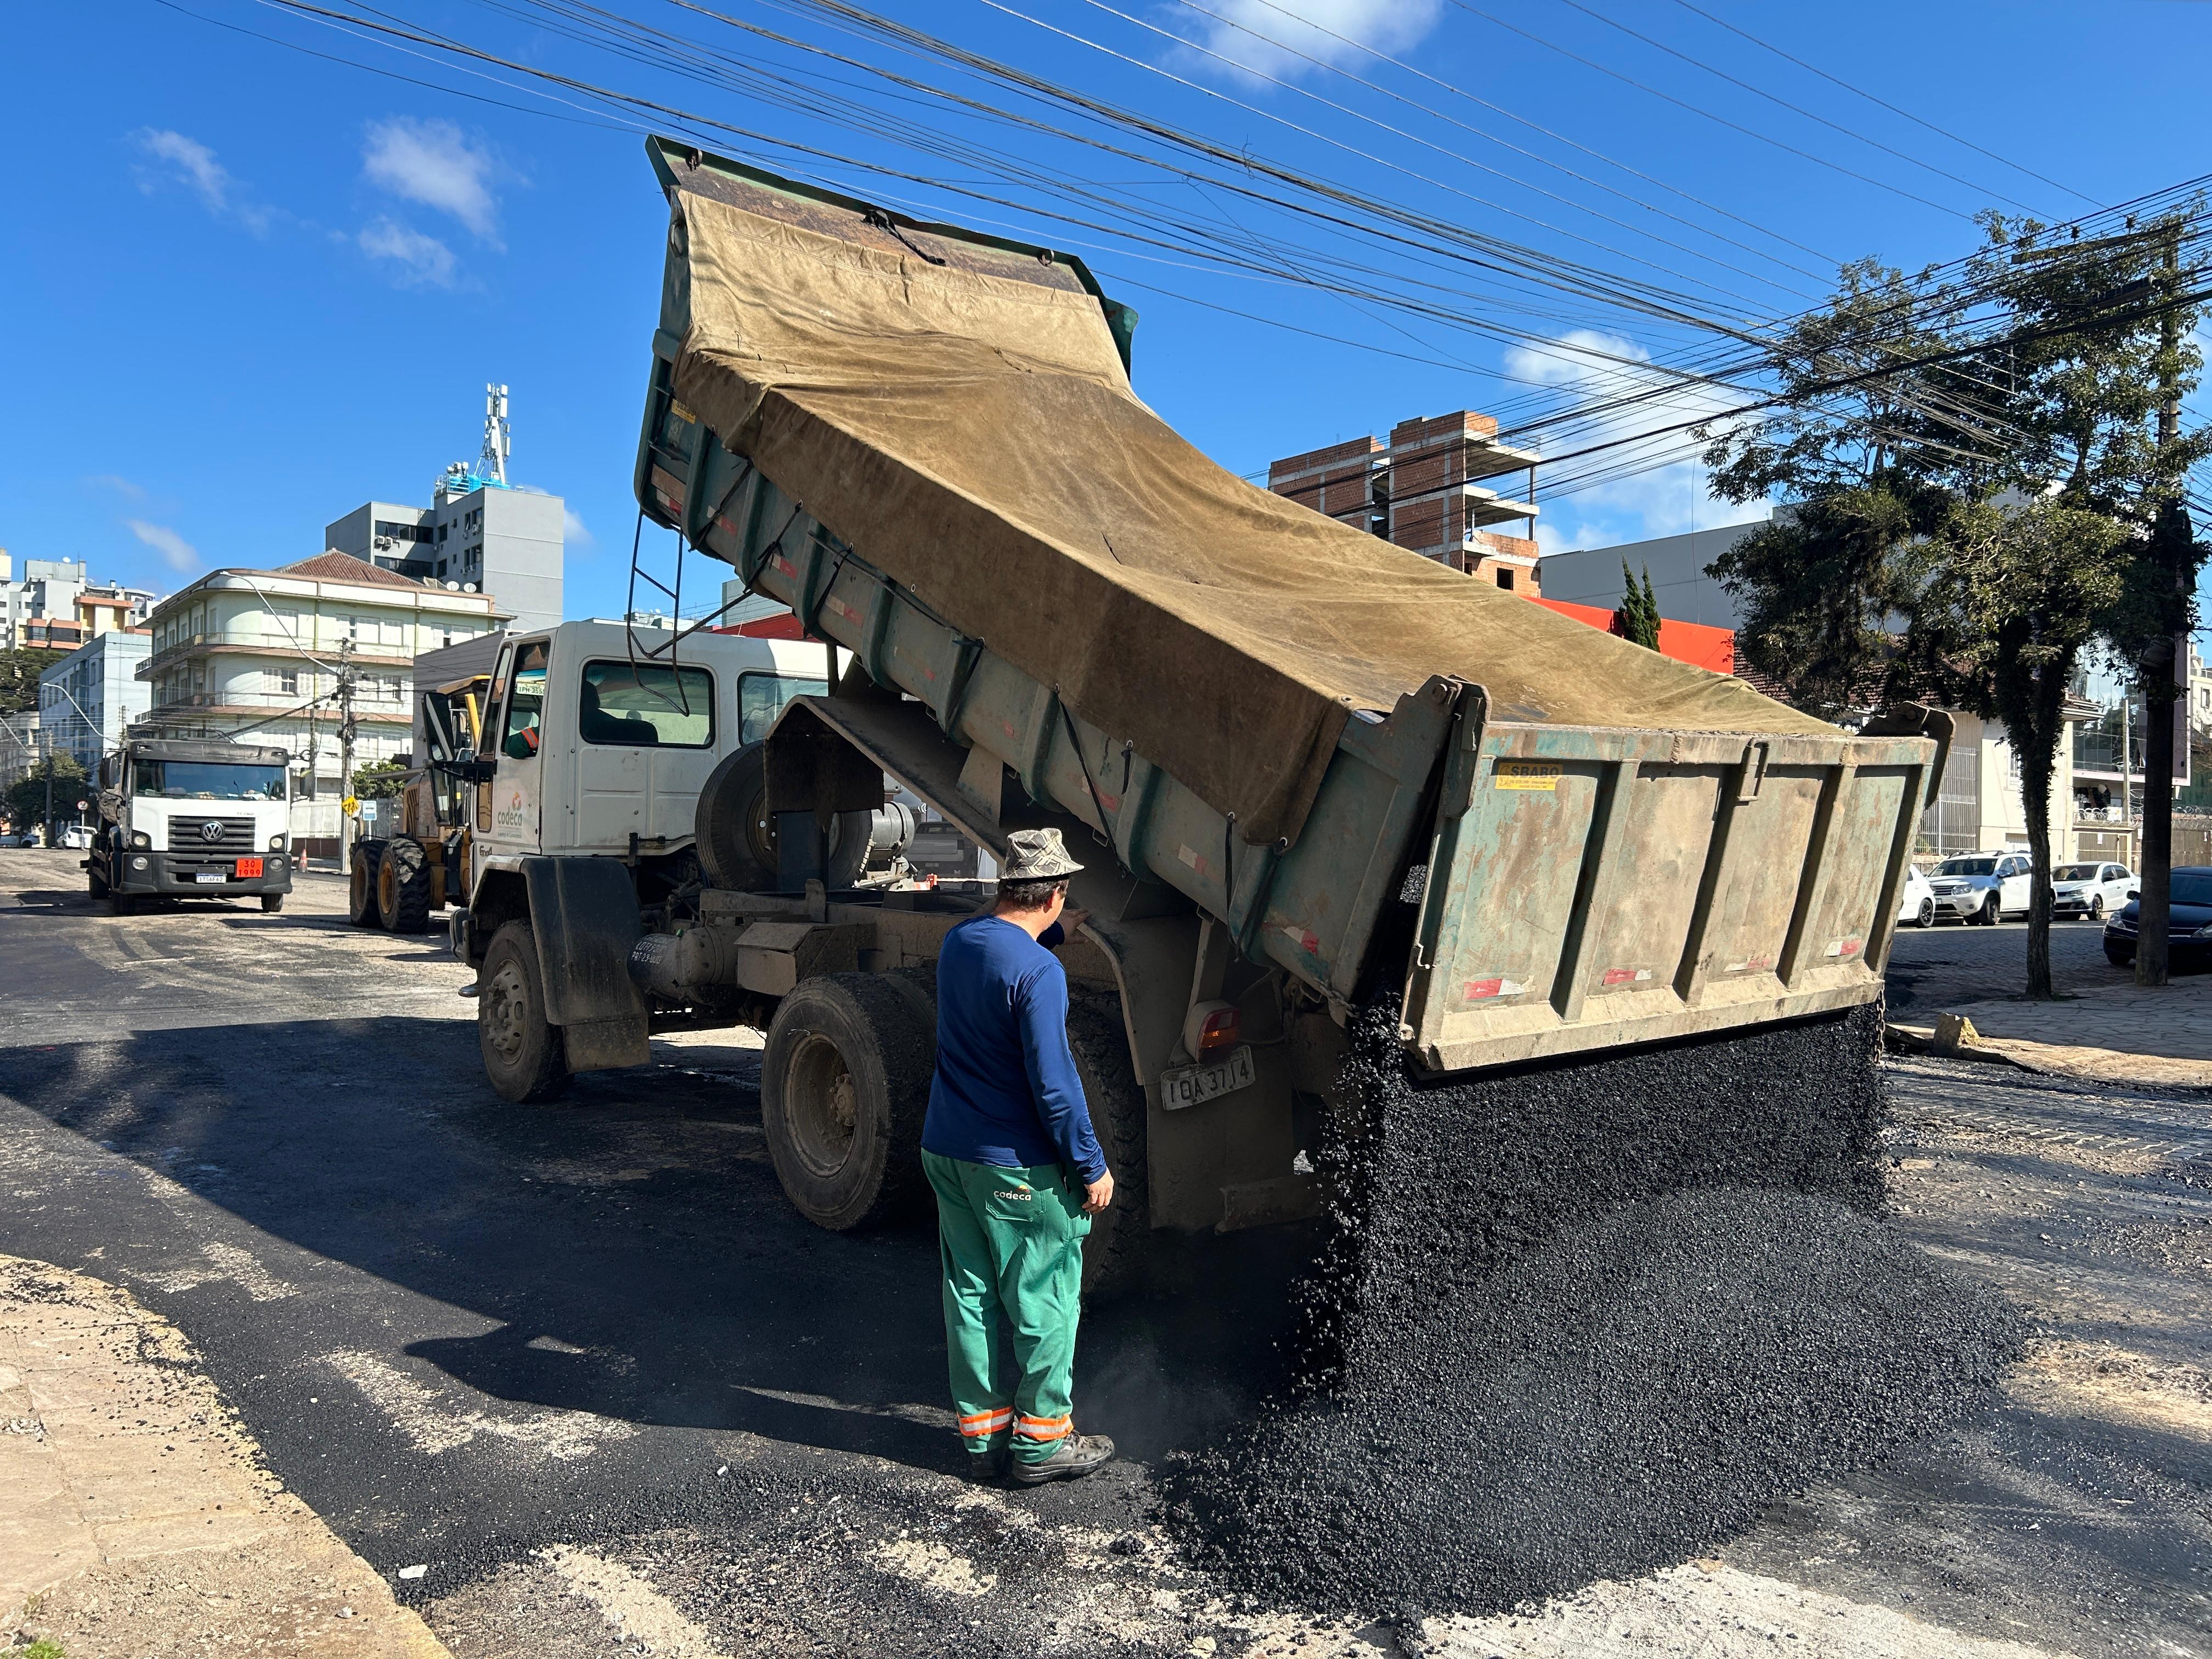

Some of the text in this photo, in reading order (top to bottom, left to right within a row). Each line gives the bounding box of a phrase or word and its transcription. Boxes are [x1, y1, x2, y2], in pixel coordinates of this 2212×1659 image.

[1511, 766, 1559, 778] SBABO
[498, 806, 522, 826] codeca
[1207, 1058, 1249, 1091] 3714
[994, 1190, 1031, 1201] codeca
